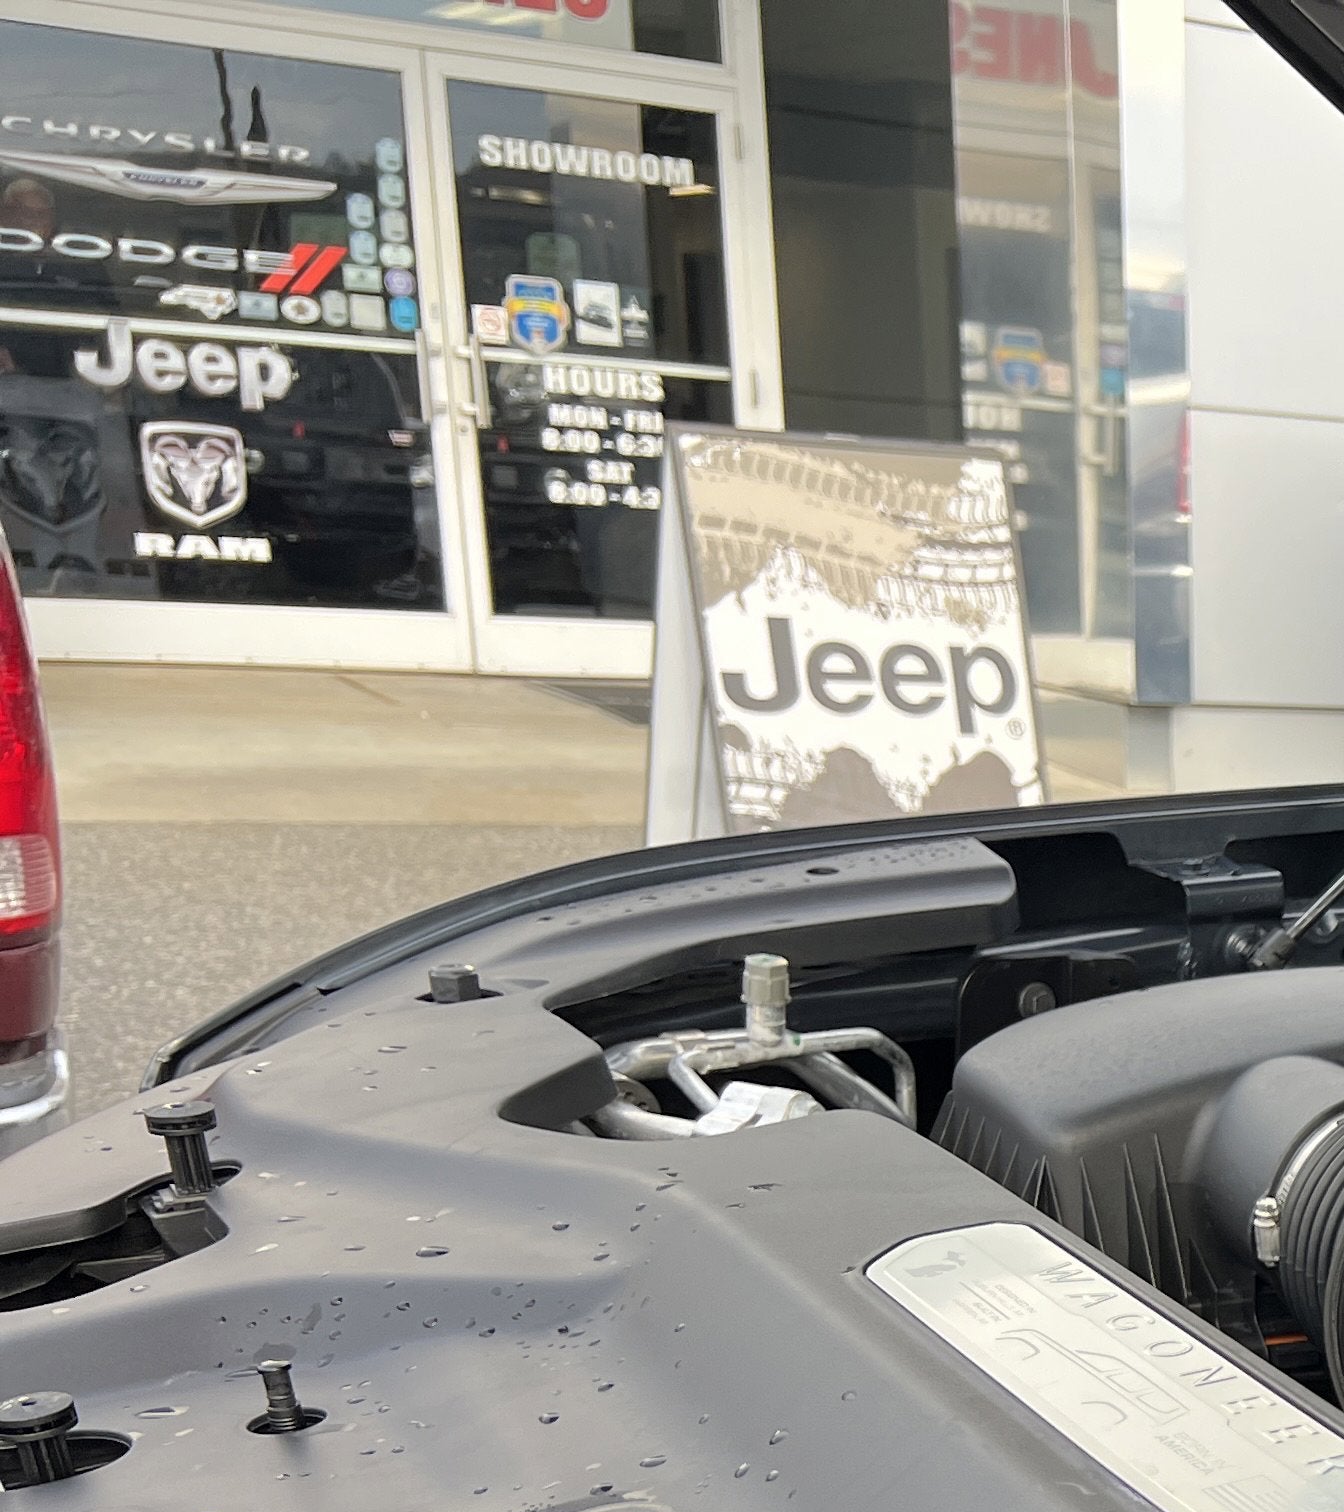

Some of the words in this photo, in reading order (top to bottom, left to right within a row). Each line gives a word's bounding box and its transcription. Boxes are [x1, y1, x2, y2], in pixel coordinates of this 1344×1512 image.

[1, 116, 310, 162] CHRYSLER
[478, 134, 696, 187] SHOWROOM
[0, 228, 298, 275] DODGE
[73, 319, 293, 411] Jeep
[543, 363, 664, 401] HOURS
[585, 458, 635, 485] SAT
[133, 531, 273, 563] RAM
[721, 616, 1016, 735] Jeep
[1154, 1436, 1214, 1475] AMERICA
